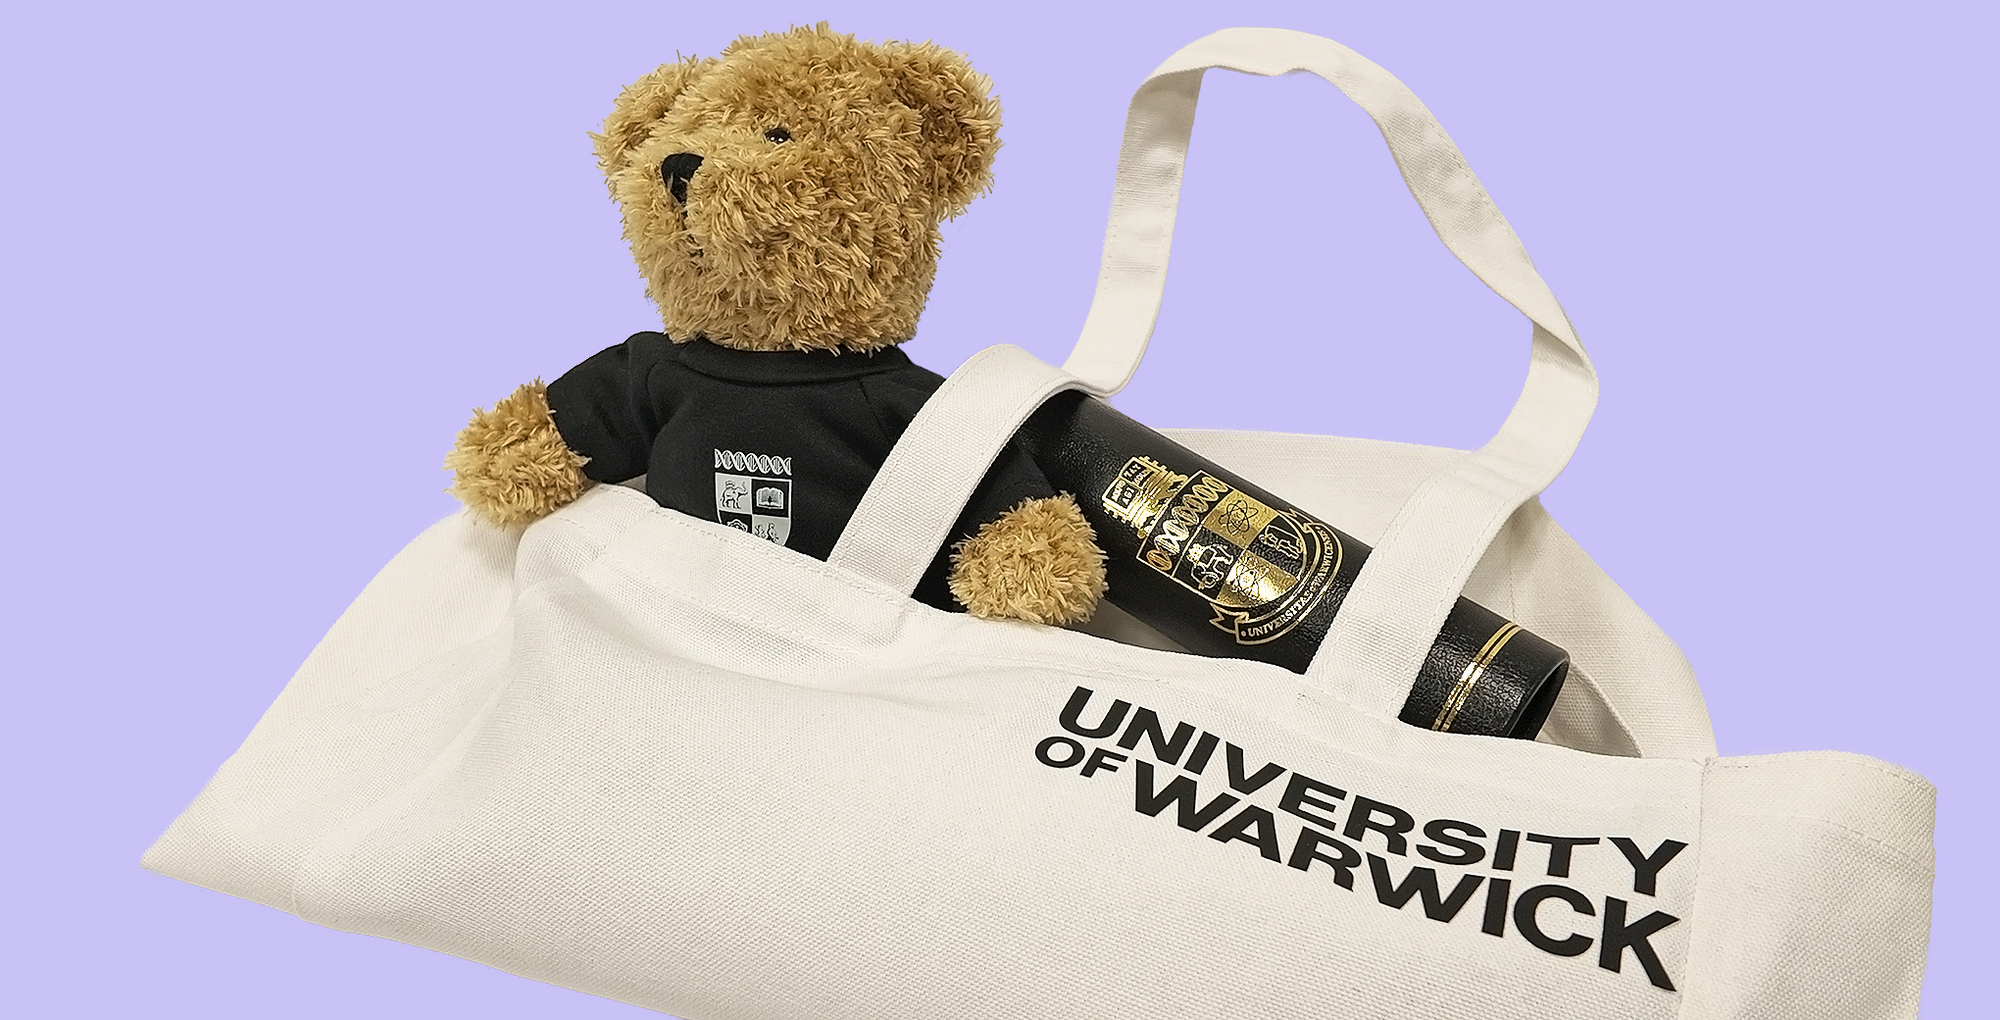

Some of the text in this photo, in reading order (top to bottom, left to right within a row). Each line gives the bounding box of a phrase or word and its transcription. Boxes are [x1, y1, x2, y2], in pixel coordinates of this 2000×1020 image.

[1034, 736, 1681, 993] OF WARWICK
[1058, 686, 1689, 898] UNIVERSITY
